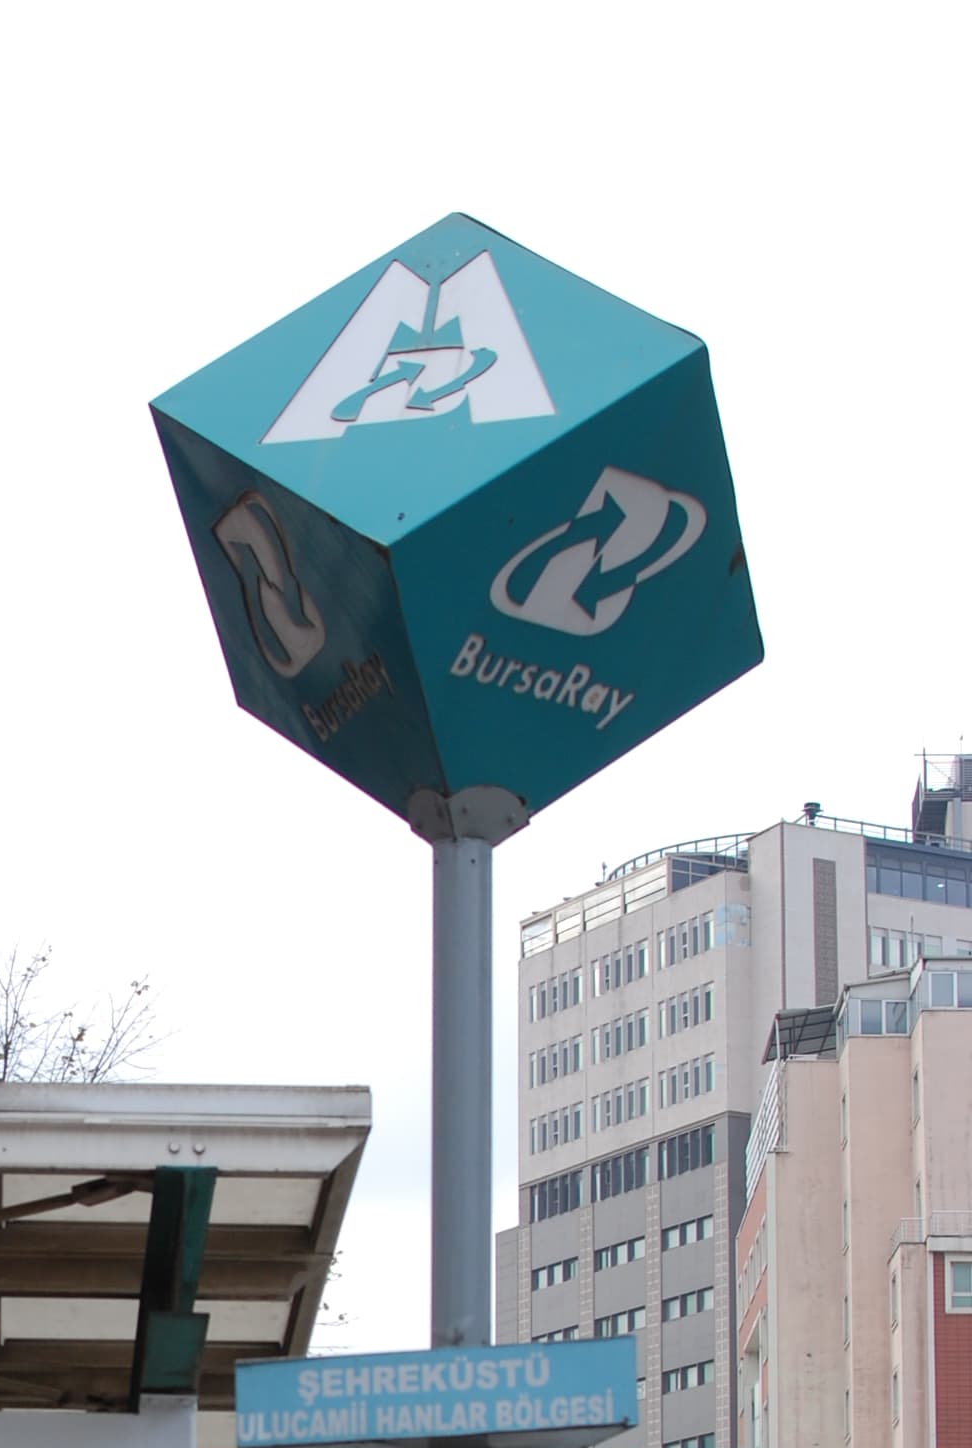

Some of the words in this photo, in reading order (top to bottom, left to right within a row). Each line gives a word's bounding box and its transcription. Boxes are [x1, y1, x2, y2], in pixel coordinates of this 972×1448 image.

[299, 650, 396, 743] BursaRay
[450, 633, 634, 730] BursaRay
[238, 1402, 368, 1442] ULUCAMİİ
[376, 1403, 488, 1435] HANLAR
[496, 1389, 615, 1428] BÖLGESİ
[297, 1353, 550, 1406] ŞEHREKÜSTÜ
